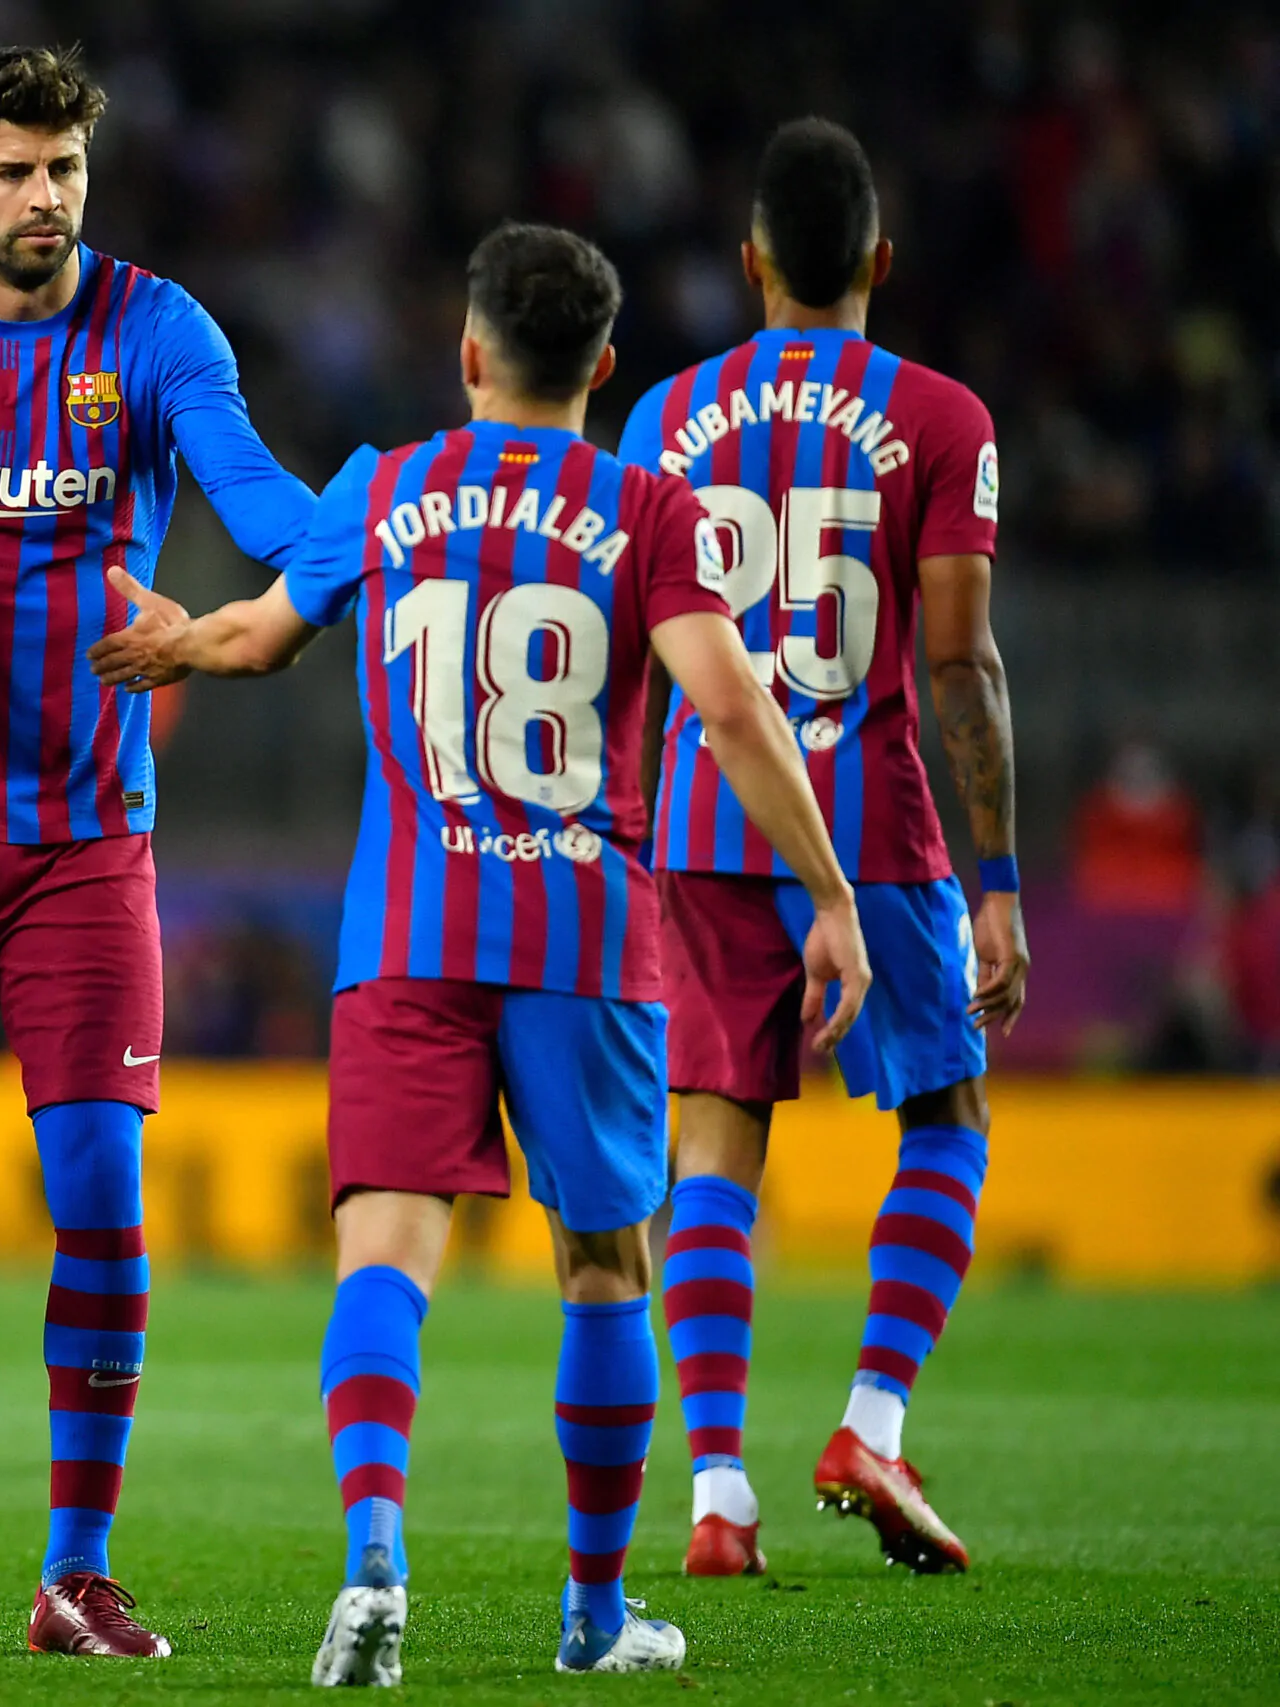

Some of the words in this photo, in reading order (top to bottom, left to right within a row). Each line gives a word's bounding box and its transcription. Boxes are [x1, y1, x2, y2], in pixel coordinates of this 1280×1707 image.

[83, 395, 104, 403] FCB
[659, 380, 910, 477] AUBAMEYANG
[383, 578, 609, 817] 18
[440, 826, 552, 862] unicef
